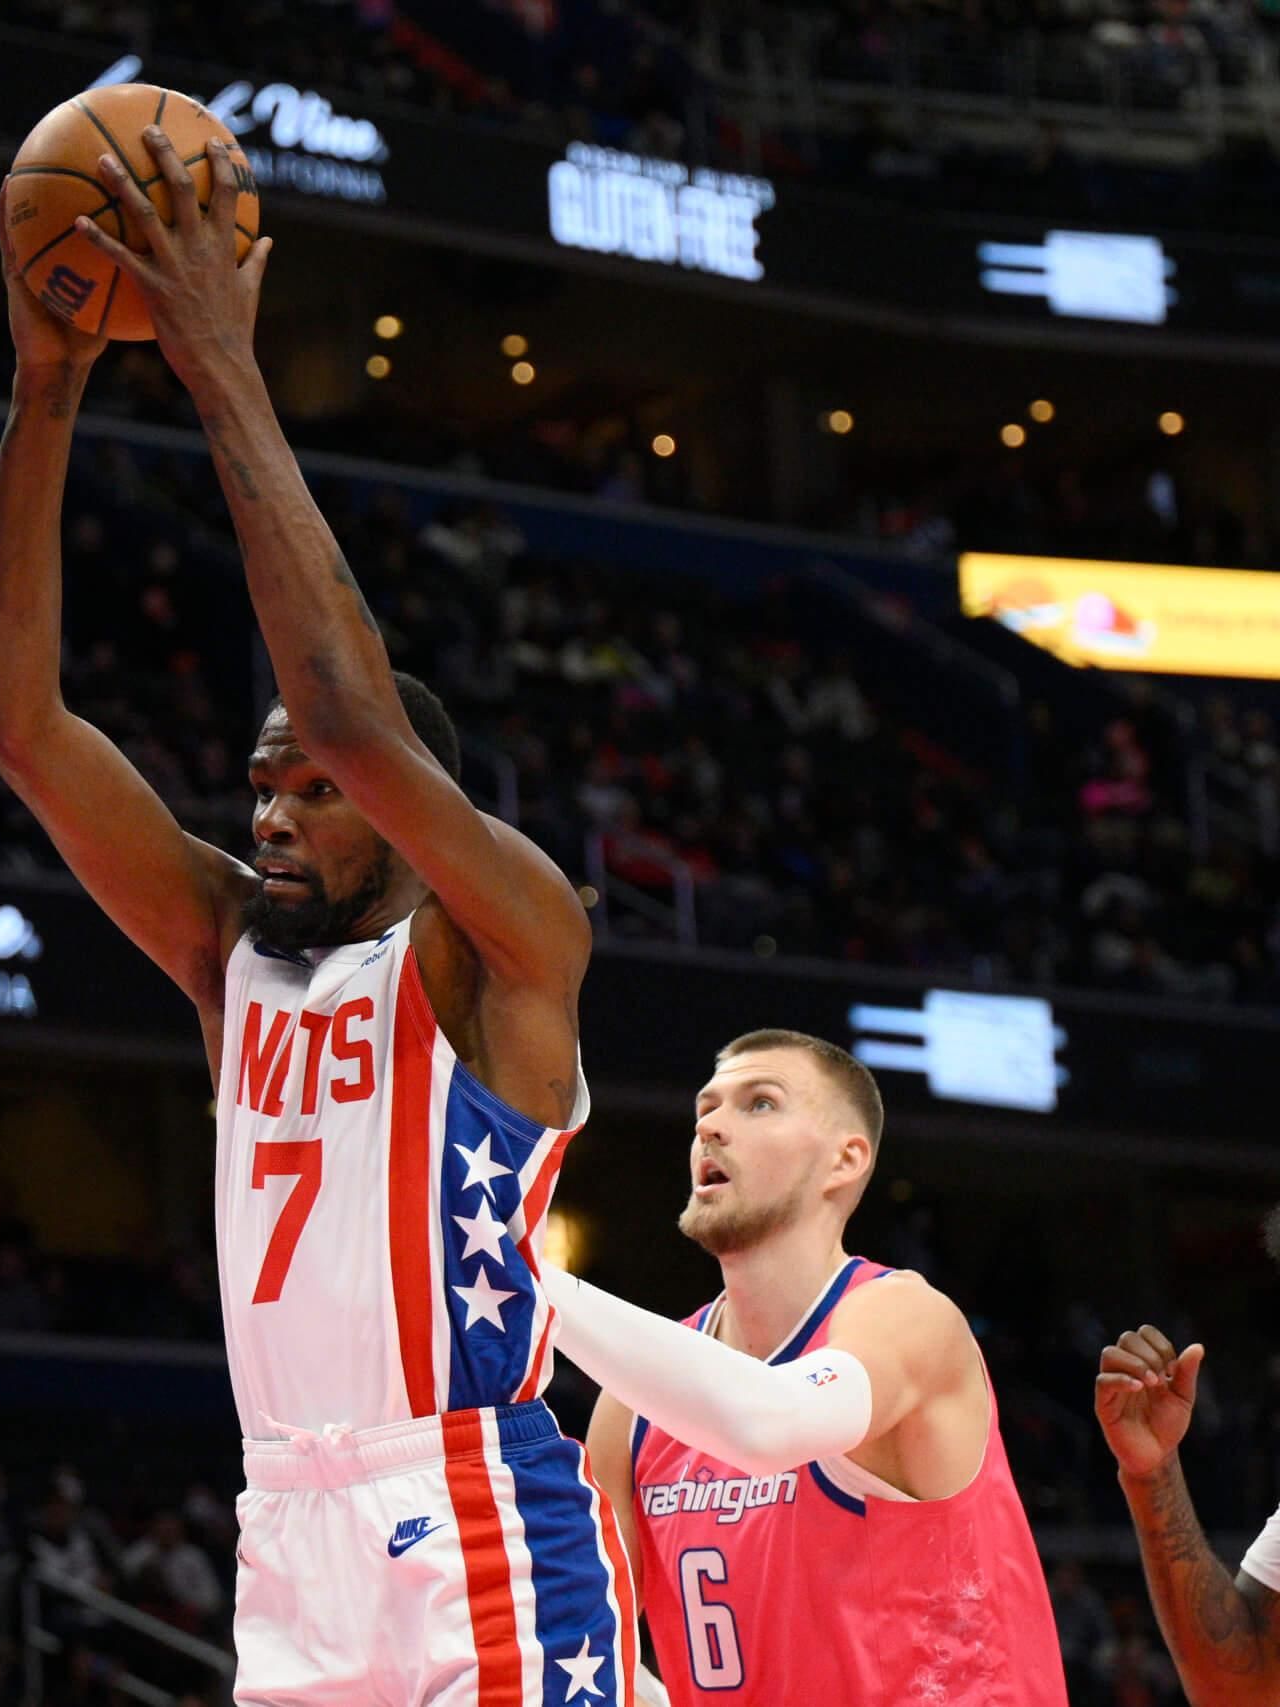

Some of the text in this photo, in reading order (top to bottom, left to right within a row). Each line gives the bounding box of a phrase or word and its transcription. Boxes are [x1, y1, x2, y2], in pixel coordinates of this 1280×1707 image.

[251, 1137, 323, 1306] 7
[393, 1516, 431, 1541] NIKE
[679, 1547, 745, 1691] 6
